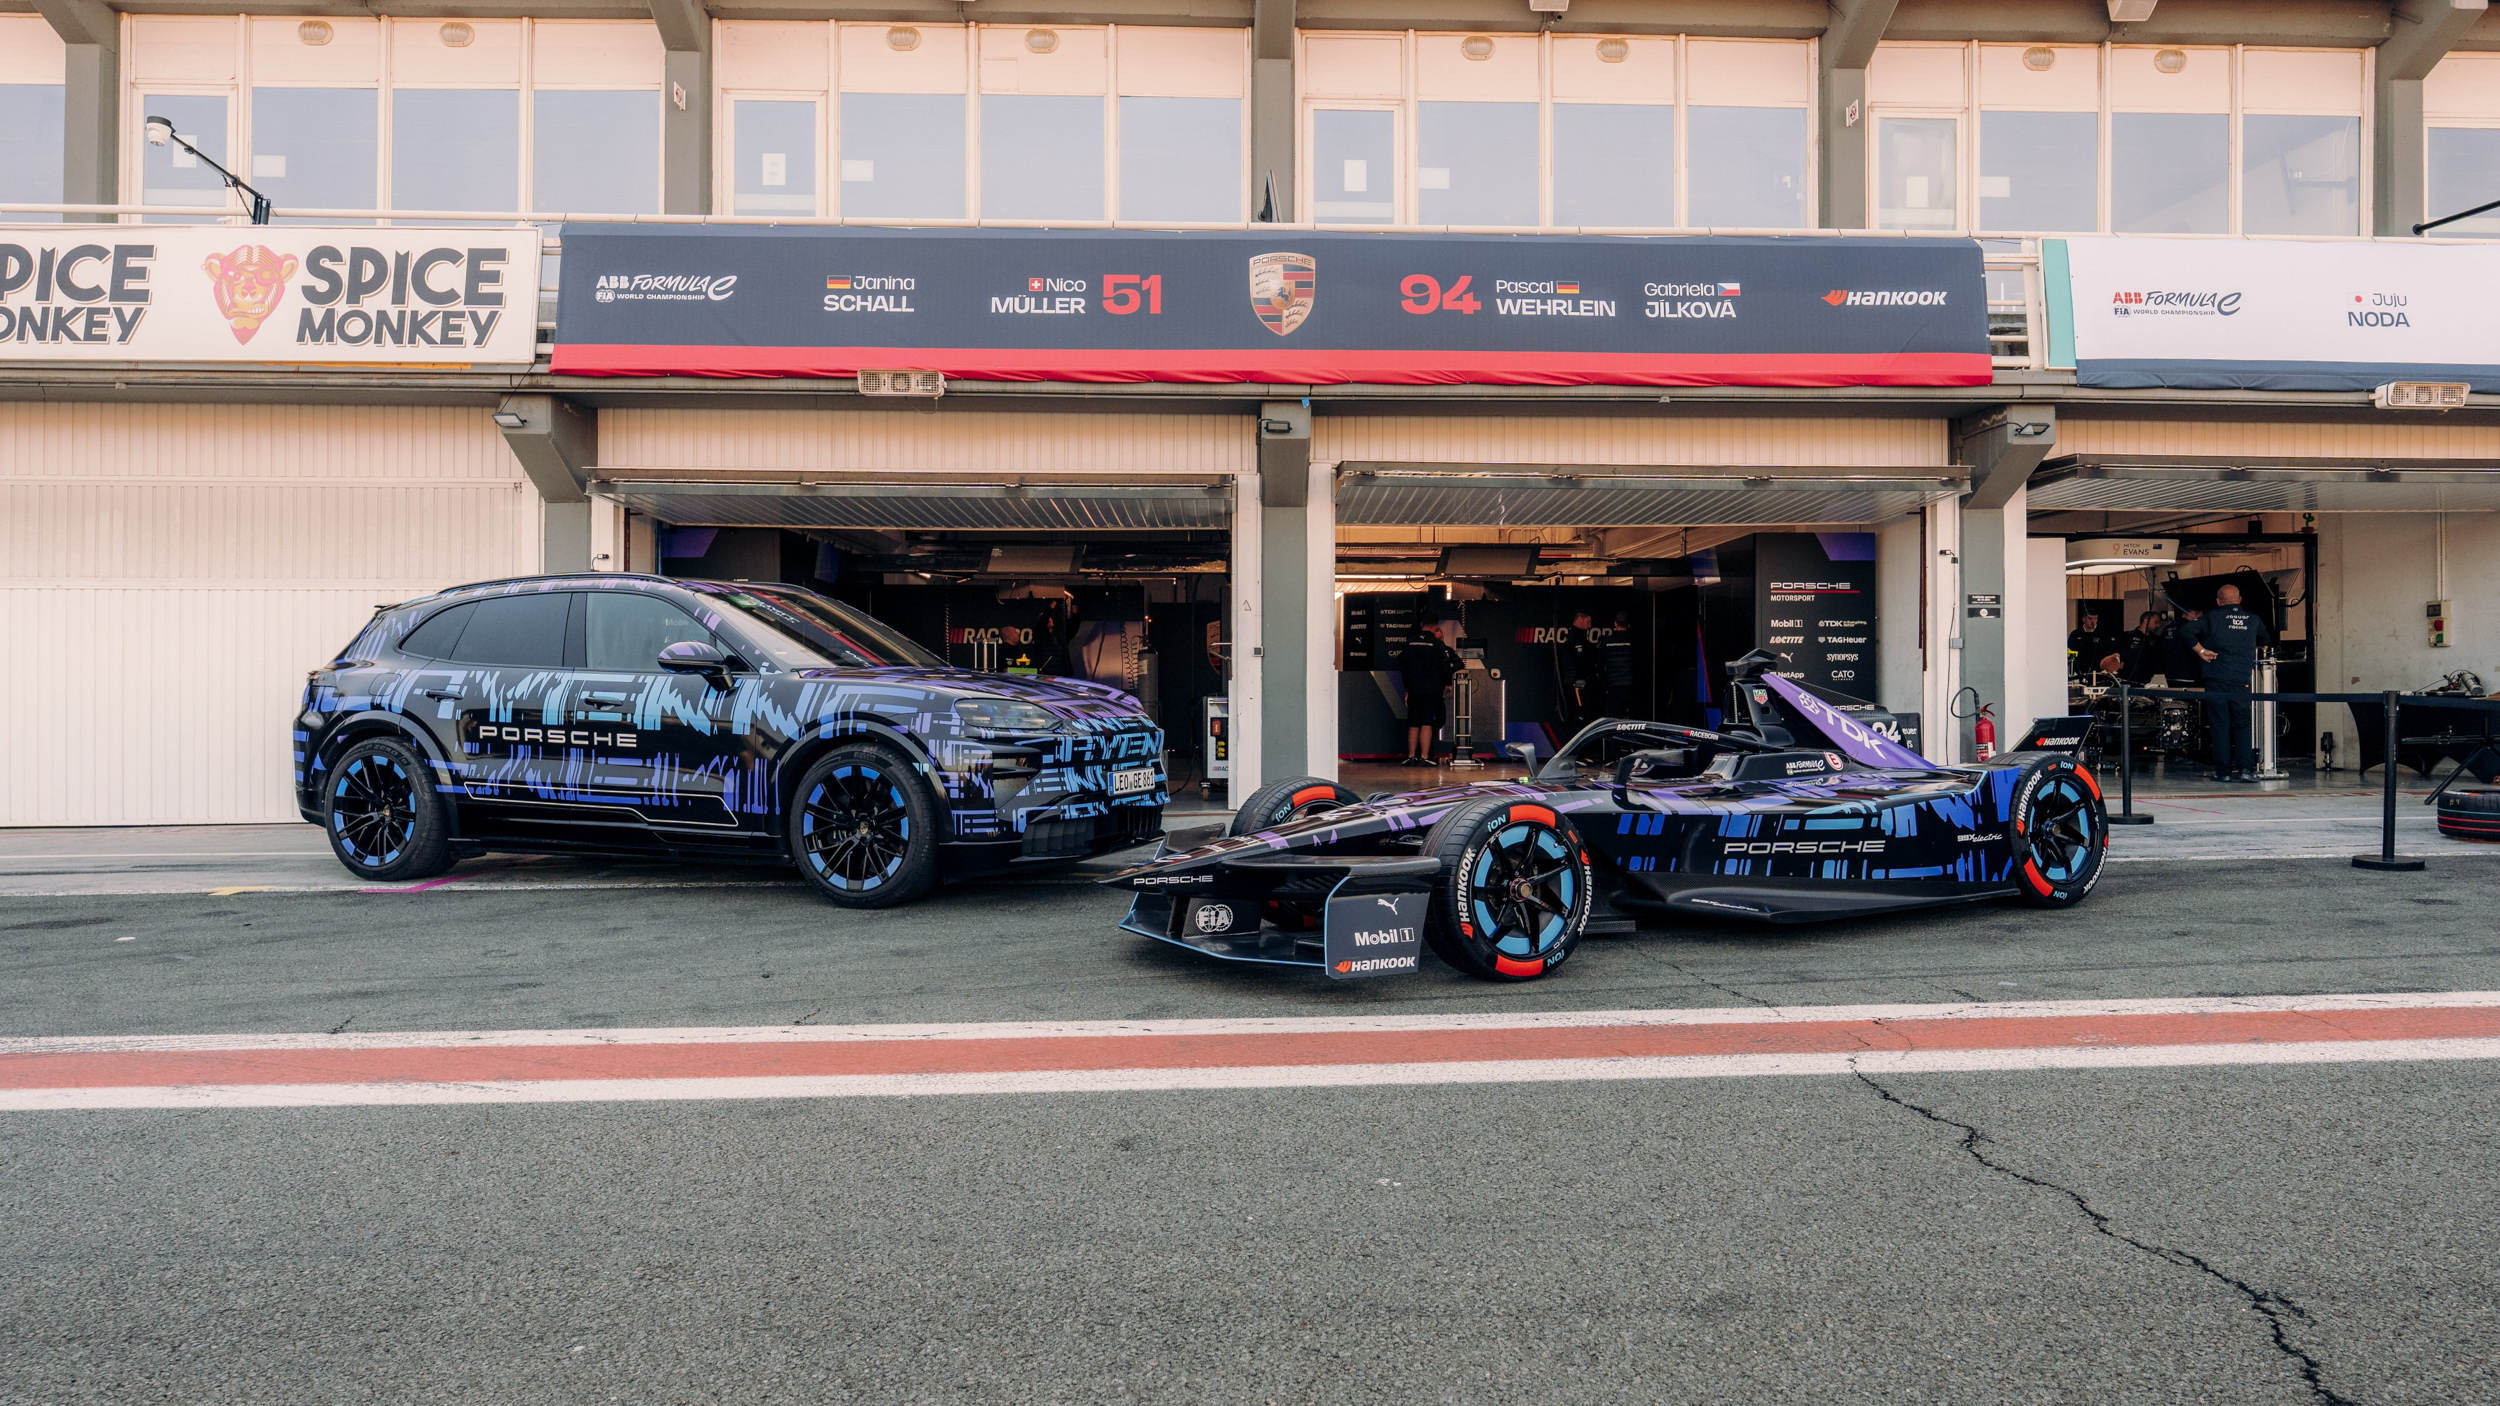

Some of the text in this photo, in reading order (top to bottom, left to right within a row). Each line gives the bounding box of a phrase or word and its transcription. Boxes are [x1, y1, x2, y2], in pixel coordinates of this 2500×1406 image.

[1253, 255, 1311, 266] PORSCHE
[0, 243, 155, 303] PICE
[301, 245, 508, 306] SPICE
[596, 275, 630, 289] ABB
[630, 274, 711, 292] FORMULA
[853, 275, 915, 290] Janina
[1046, 278, 1087, 292] Nico
[1496, 280, 1554, 294] Pascal
[1644, 282, 1715, 297] Gabriela
[646, 293, 706, 301] CHAMPIONSHIP
[1102, 274, 1162, 315] 51
[1400, 273, 1482, 315] 94
[2112, 292, 2143, 304] ABB
[2144, 290, 2218, 308] FORMULA
[2372, 293, 2408, 308] Juju
[823, 294, 915, 313] SCHALL
[991, 294, 1086, 314] MÜLLER
[1496, 298, 1616, 317] WEHRLEIN
[1644, 299, 1737, 318] JÍLKOVÁ
[296, 307, 500, 346] MONKEY
[2347, 311, 2411, 328] NODA
[2112, 543, 2120, 555] 9
[2123, 548, 2150, 556] EVANS
[1770, 582, 1851, 590] PORSCHE
[1770, 594, 1815, 602] MOTORSPORT
[1770, 620, 1794, 628] Mobil
[1769, 636, 1805, 644] LOCTITE
[1777, 671, 1805, 679] NetApp
[1831, 669, 1855, 678] CATO
[1616, 723, 1647, 731] LOCTITE
[1817, 701, 1887, 760] TDK
[479, 725, 638, 748] PORSCHE
[1689, 730, 1719, 741] RACEBORN
[1114, 770, 1154, 791] LEO GE 861
[1724, 839, 1886, 855] PORSCHE
[1133, 874, 1214, 886] PORSCHE
[1354, 928, 1399, 947] Mobil
